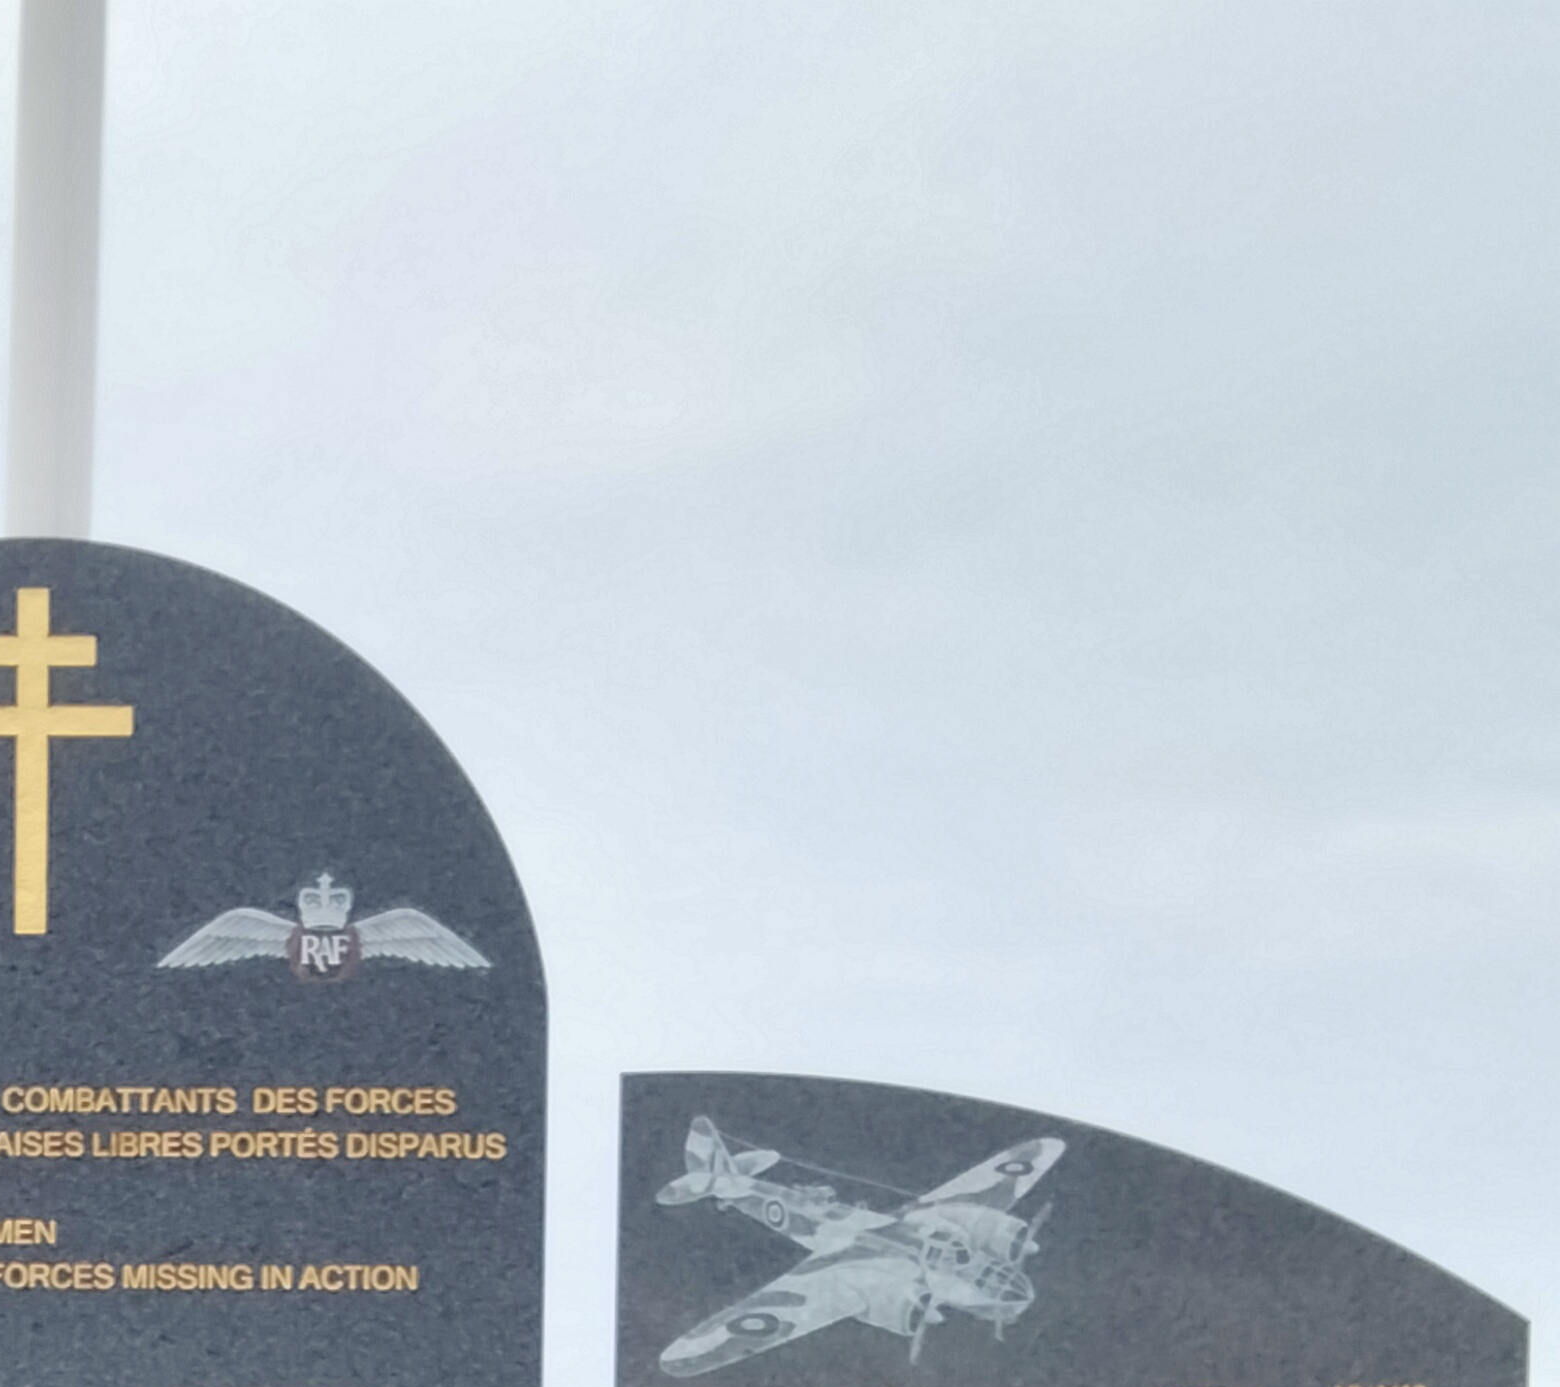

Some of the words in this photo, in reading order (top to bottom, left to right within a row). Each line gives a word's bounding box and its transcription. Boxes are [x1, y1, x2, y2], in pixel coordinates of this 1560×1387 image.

[300, 935, 349, 972] RAF
[2, 1086, 237, 1114] COMBATTANTS
[253, 1087, 318, 1113] DES
[325, 1088, 456, 1115] FORCES
[92, 1132, 203, 1157] LIBRES
[210, 1128, 339, 1158] PORTÉS
[346, 1132, 506, 1159] DISPARUS
[122, 1263, 253, 1290] MISSING
[261, 1265, 291, 1289] IN
[298, 1265, 418, 1291] ACTION
